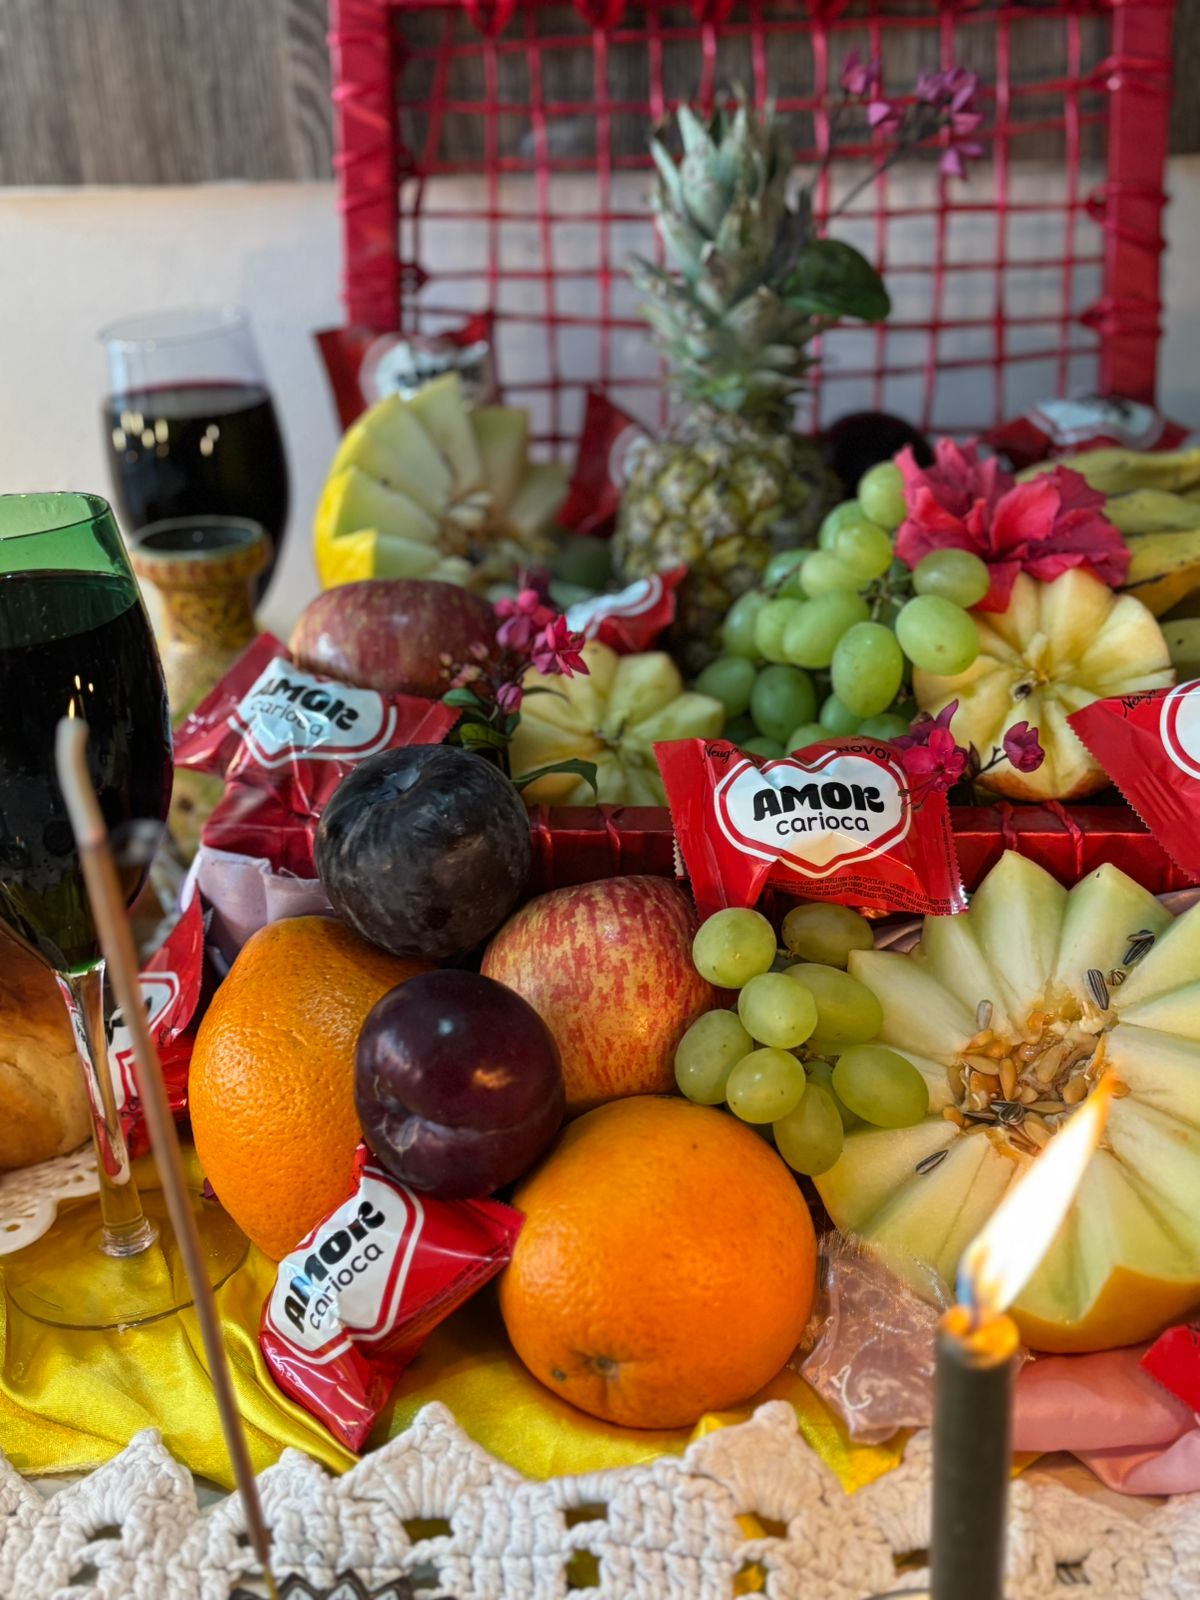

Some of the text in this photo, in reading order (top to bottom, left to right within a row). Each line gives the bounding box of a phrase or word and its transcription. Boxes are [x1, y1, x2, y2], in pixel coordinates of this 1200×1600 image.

[252, 679, 359, 731] AMOR
[753, 782, 885, 821] AMOR
[776, 811, 870, 835] carioca
[284, 1201, 386, 1334] AMOR
[309, 1243, 384, 1330] carioca
